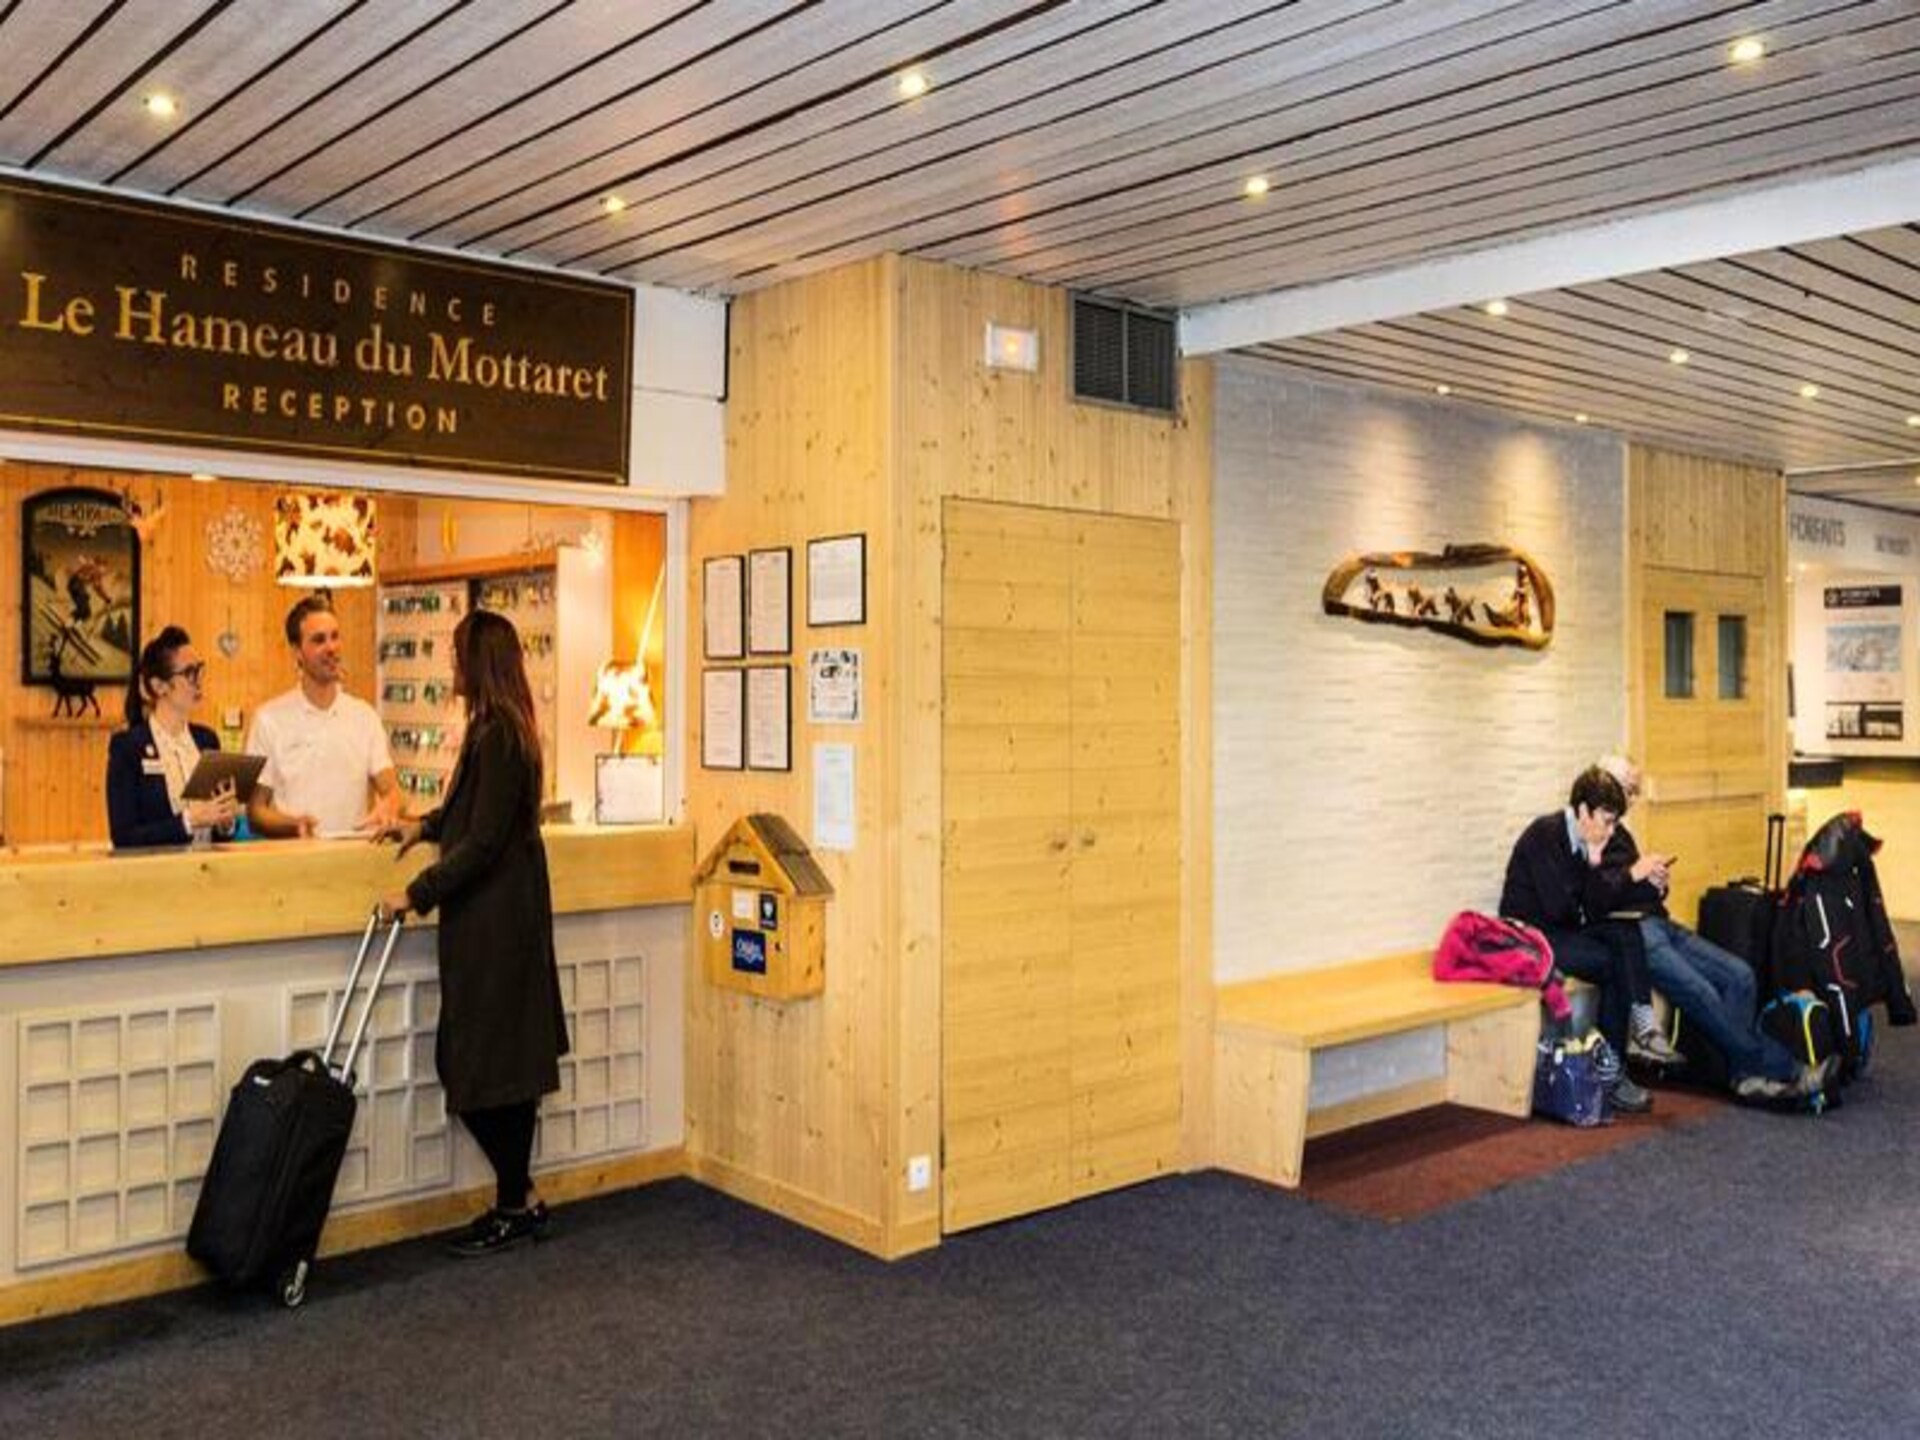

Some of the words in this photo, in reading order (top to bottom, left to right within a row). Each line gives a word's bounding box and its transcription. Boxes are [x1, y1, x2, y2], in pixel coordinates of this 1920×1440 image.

[181, 254, 497, 326] RESIDENCE
[19, 271, 95, 336] Le
[114, 284, 338, 367] Hameau
[355, 323, 414, 376] du
[427, 332, 609, 400] Mottaret
[223, 383, 458, 433] RECEPTION
